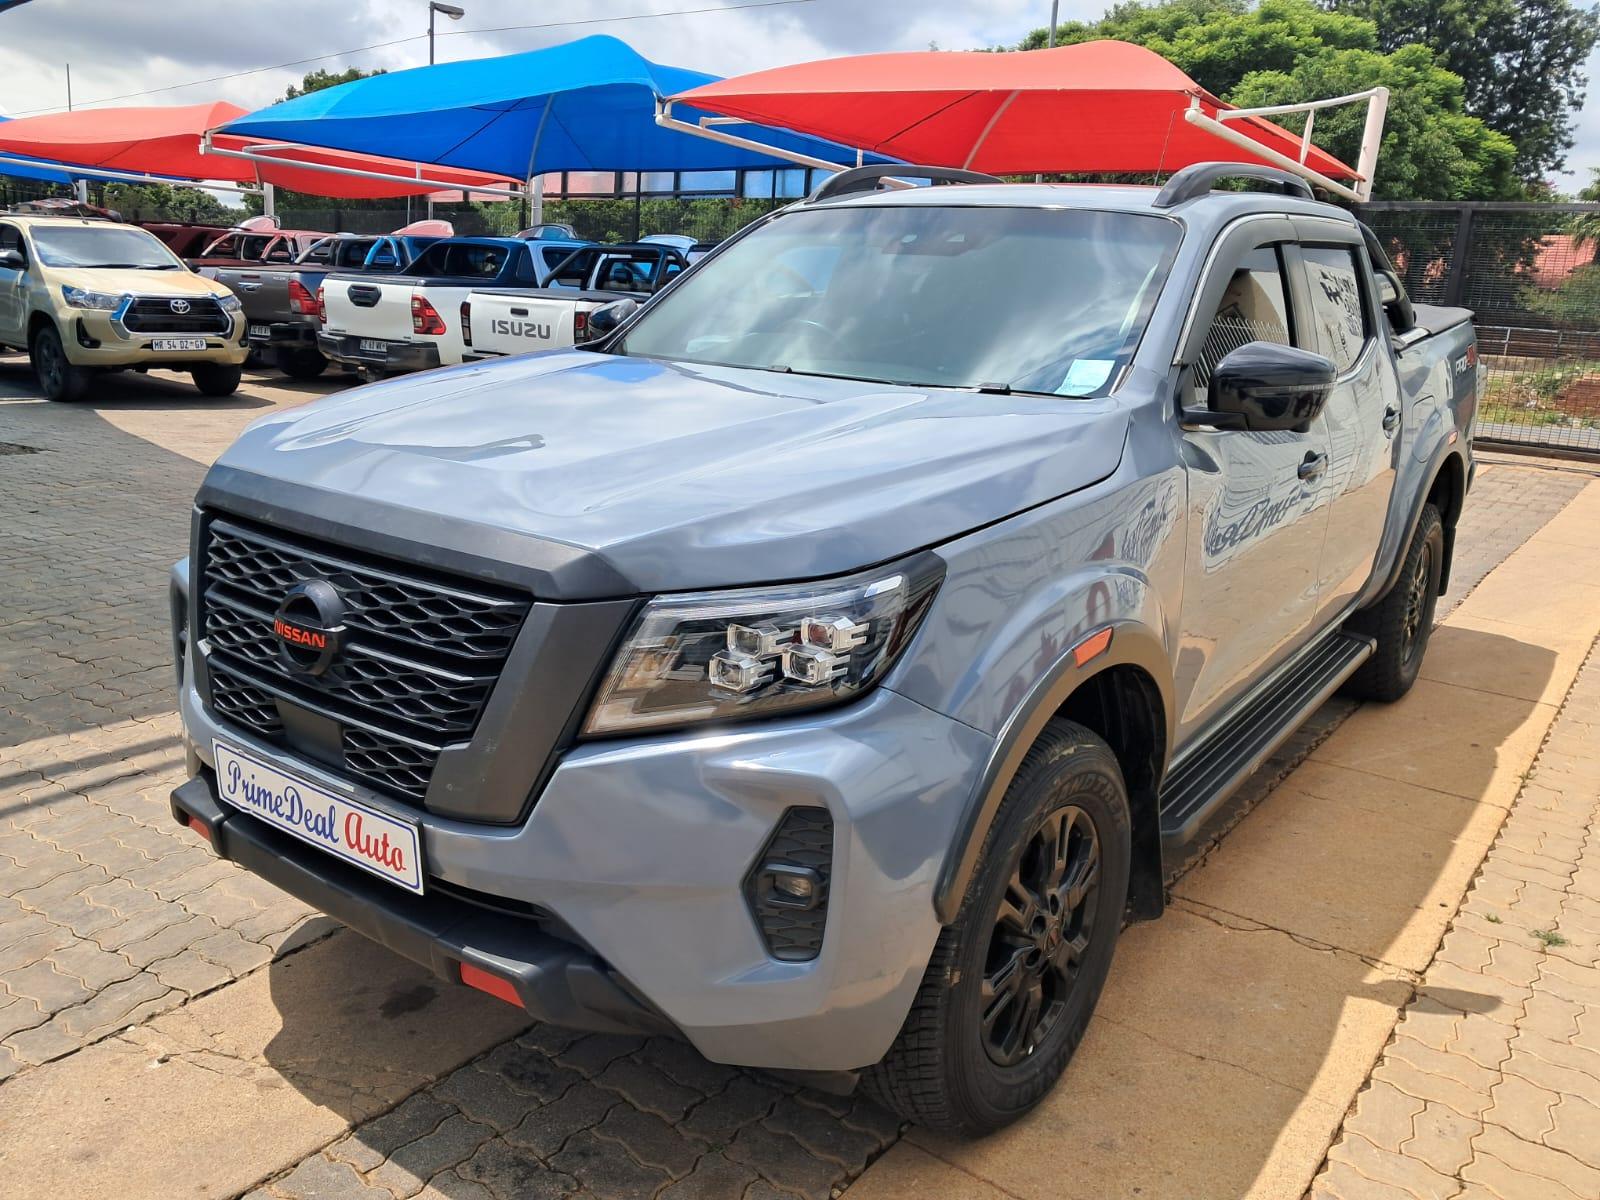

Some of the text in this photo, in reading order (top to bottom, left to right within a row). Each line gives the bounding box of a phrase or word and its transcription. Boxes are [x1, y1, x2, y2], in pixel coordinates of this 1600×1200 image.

[491, 319, 551, 340] ISUZU
[274, 618, 326, 648] NISSAN
[227, 760, 407, 872] PrimeDeal Auto
